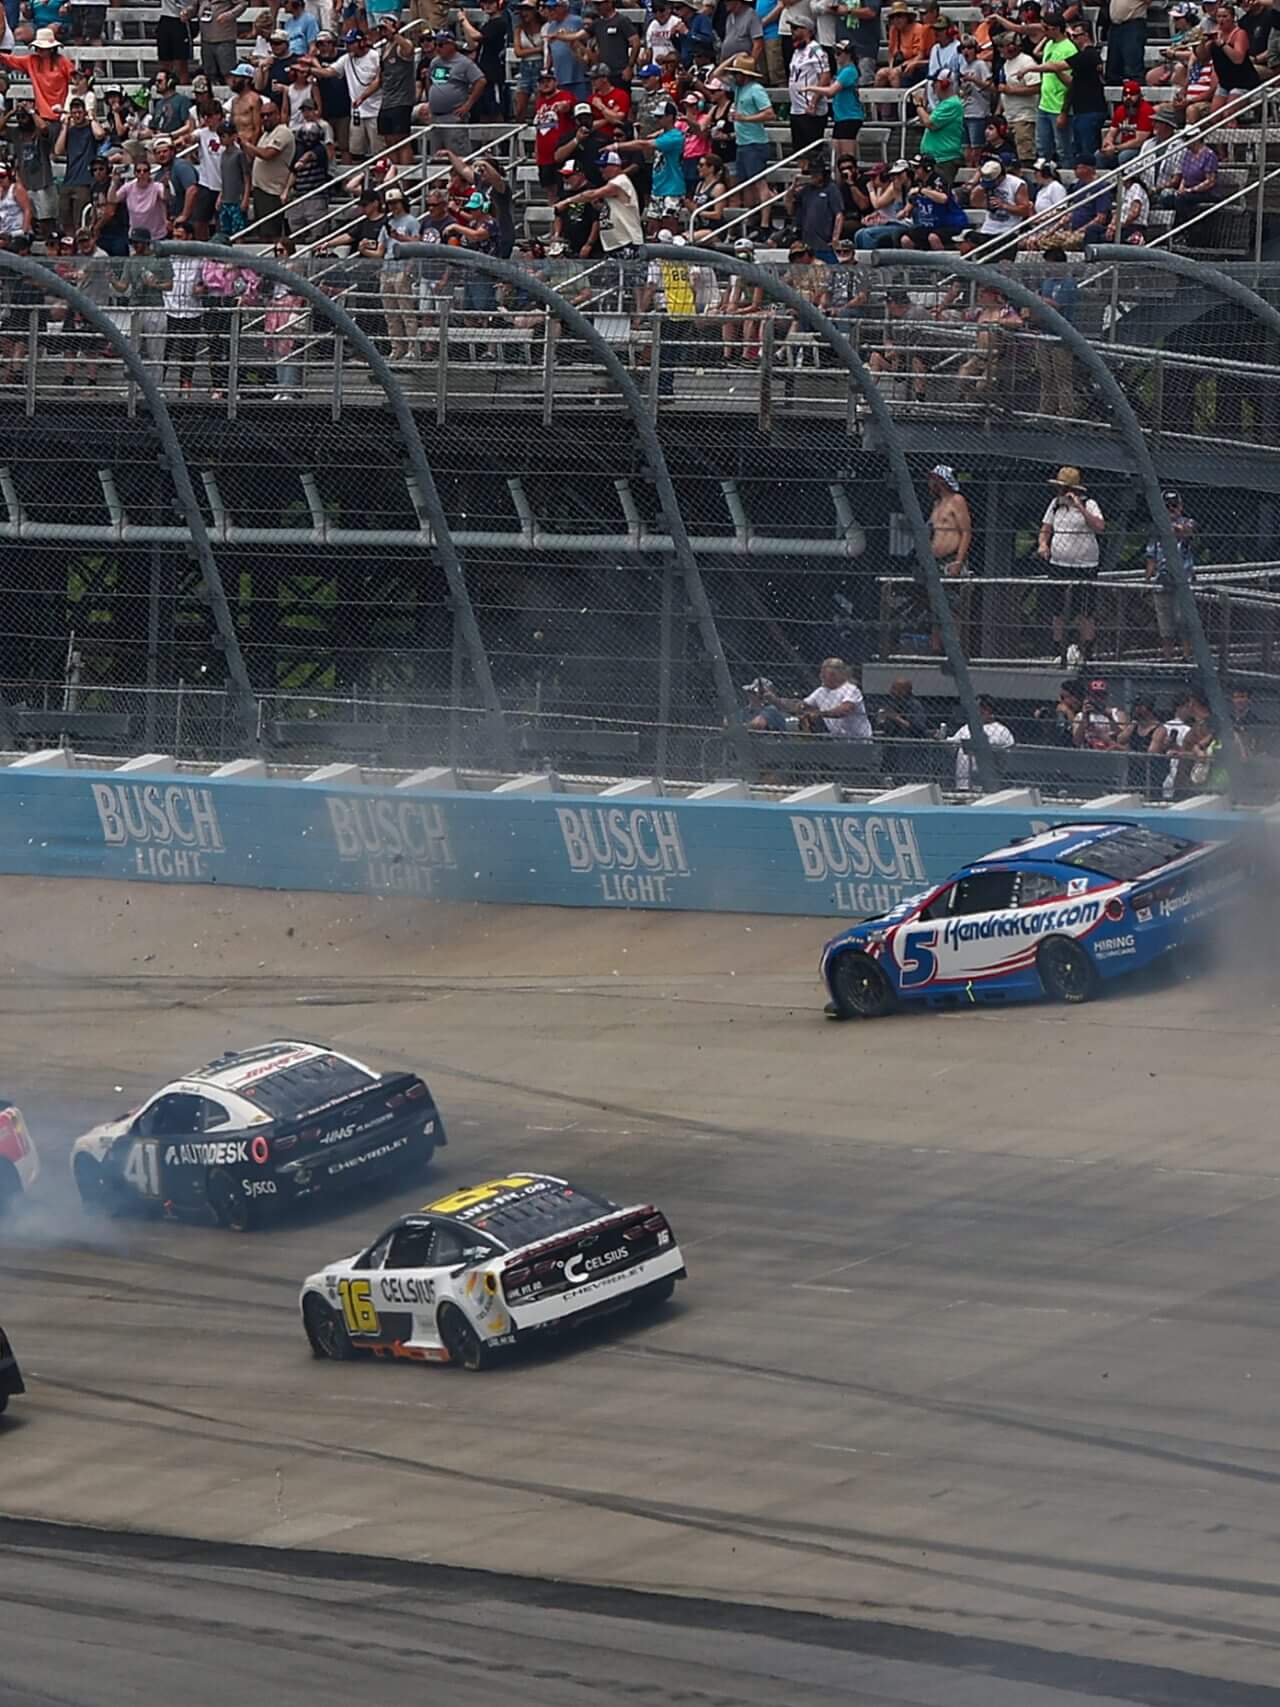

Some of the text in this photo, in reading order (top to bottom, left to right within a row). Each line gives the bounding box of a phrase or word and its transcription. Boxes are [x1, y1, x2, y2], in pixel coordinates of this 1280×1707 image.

[91, 784, 225, 853] BUSCH
[326, 797, 457, 870] BUSCH
[135, 847, 202, 877] LIGHT
[557, 807, 692, 878] BUSCH
[789, 815, 929, 886] BUSCH
[367, 863, 434, 893] LIGHT
[599, 873, 671, 903] LIGHT
[834, 881, 904, 912] LIGHT
[944, 900, 1100, 951] HendrickCars.com
[1093, 935, 1135, 952] HIRING
[899, 929, 941, 989] 5
[123, 1138, 161, 1197] 41
[179, 1141, 249, 1166] AUTODESK
[328, 1136, 409, 1175] CHEVROLET
[584, 1246, 630, 1272] CELSIUS
[338, 1278, 381, 1334] 16
[379, 1277, 437, 1305] CELSIUS
